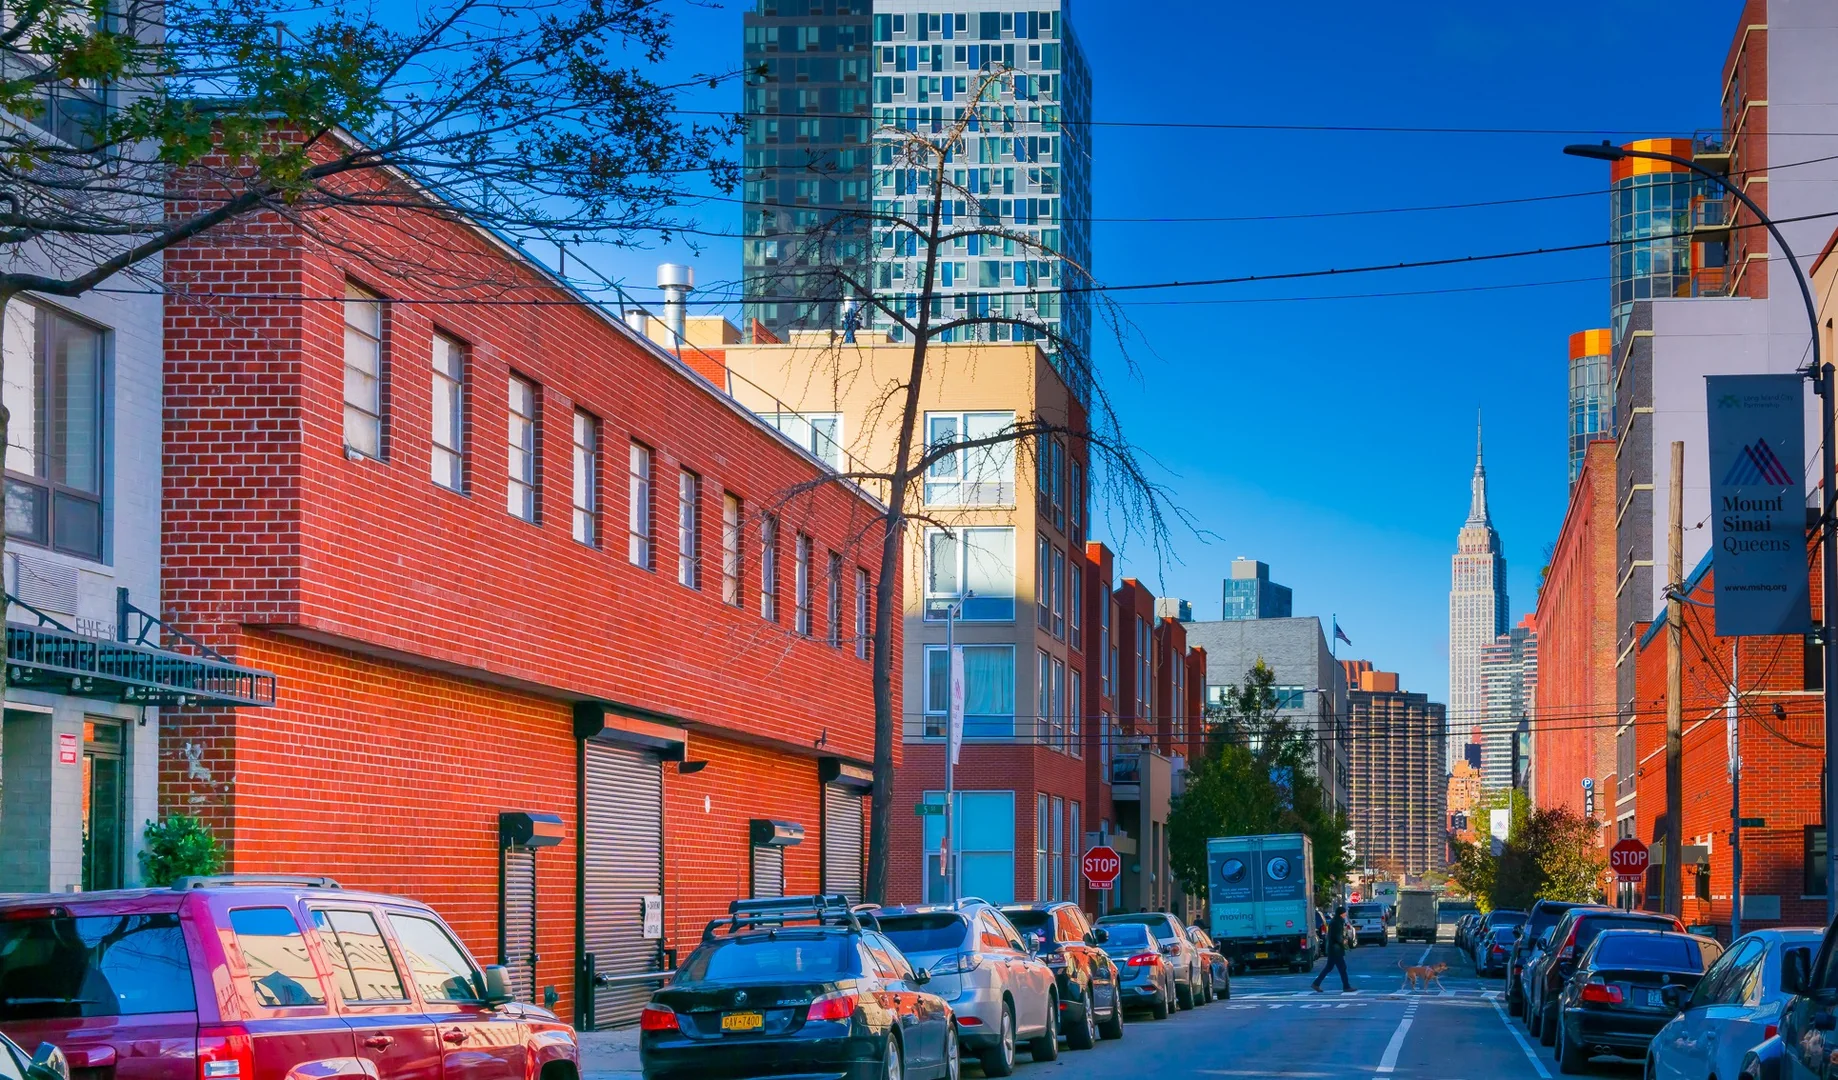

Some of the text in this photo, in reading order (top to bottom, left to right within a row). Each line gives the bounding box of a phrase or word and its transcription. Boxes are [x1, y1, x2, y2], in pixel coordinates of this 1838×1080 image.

[1721, 495, 1784, 512] Mount
[1722, 514, 1772, 532] Sinai
[1722, 536, 1791, 556] Queens
[1724, 583, 1788, 592] www.mshq.org
[1085, 858, 1118, 872] STOP
[1612, 851, 1647, 866] STOP
[1375, 888, 1394, 896] FedEx
[1219, 912, 1254, 922] moving
